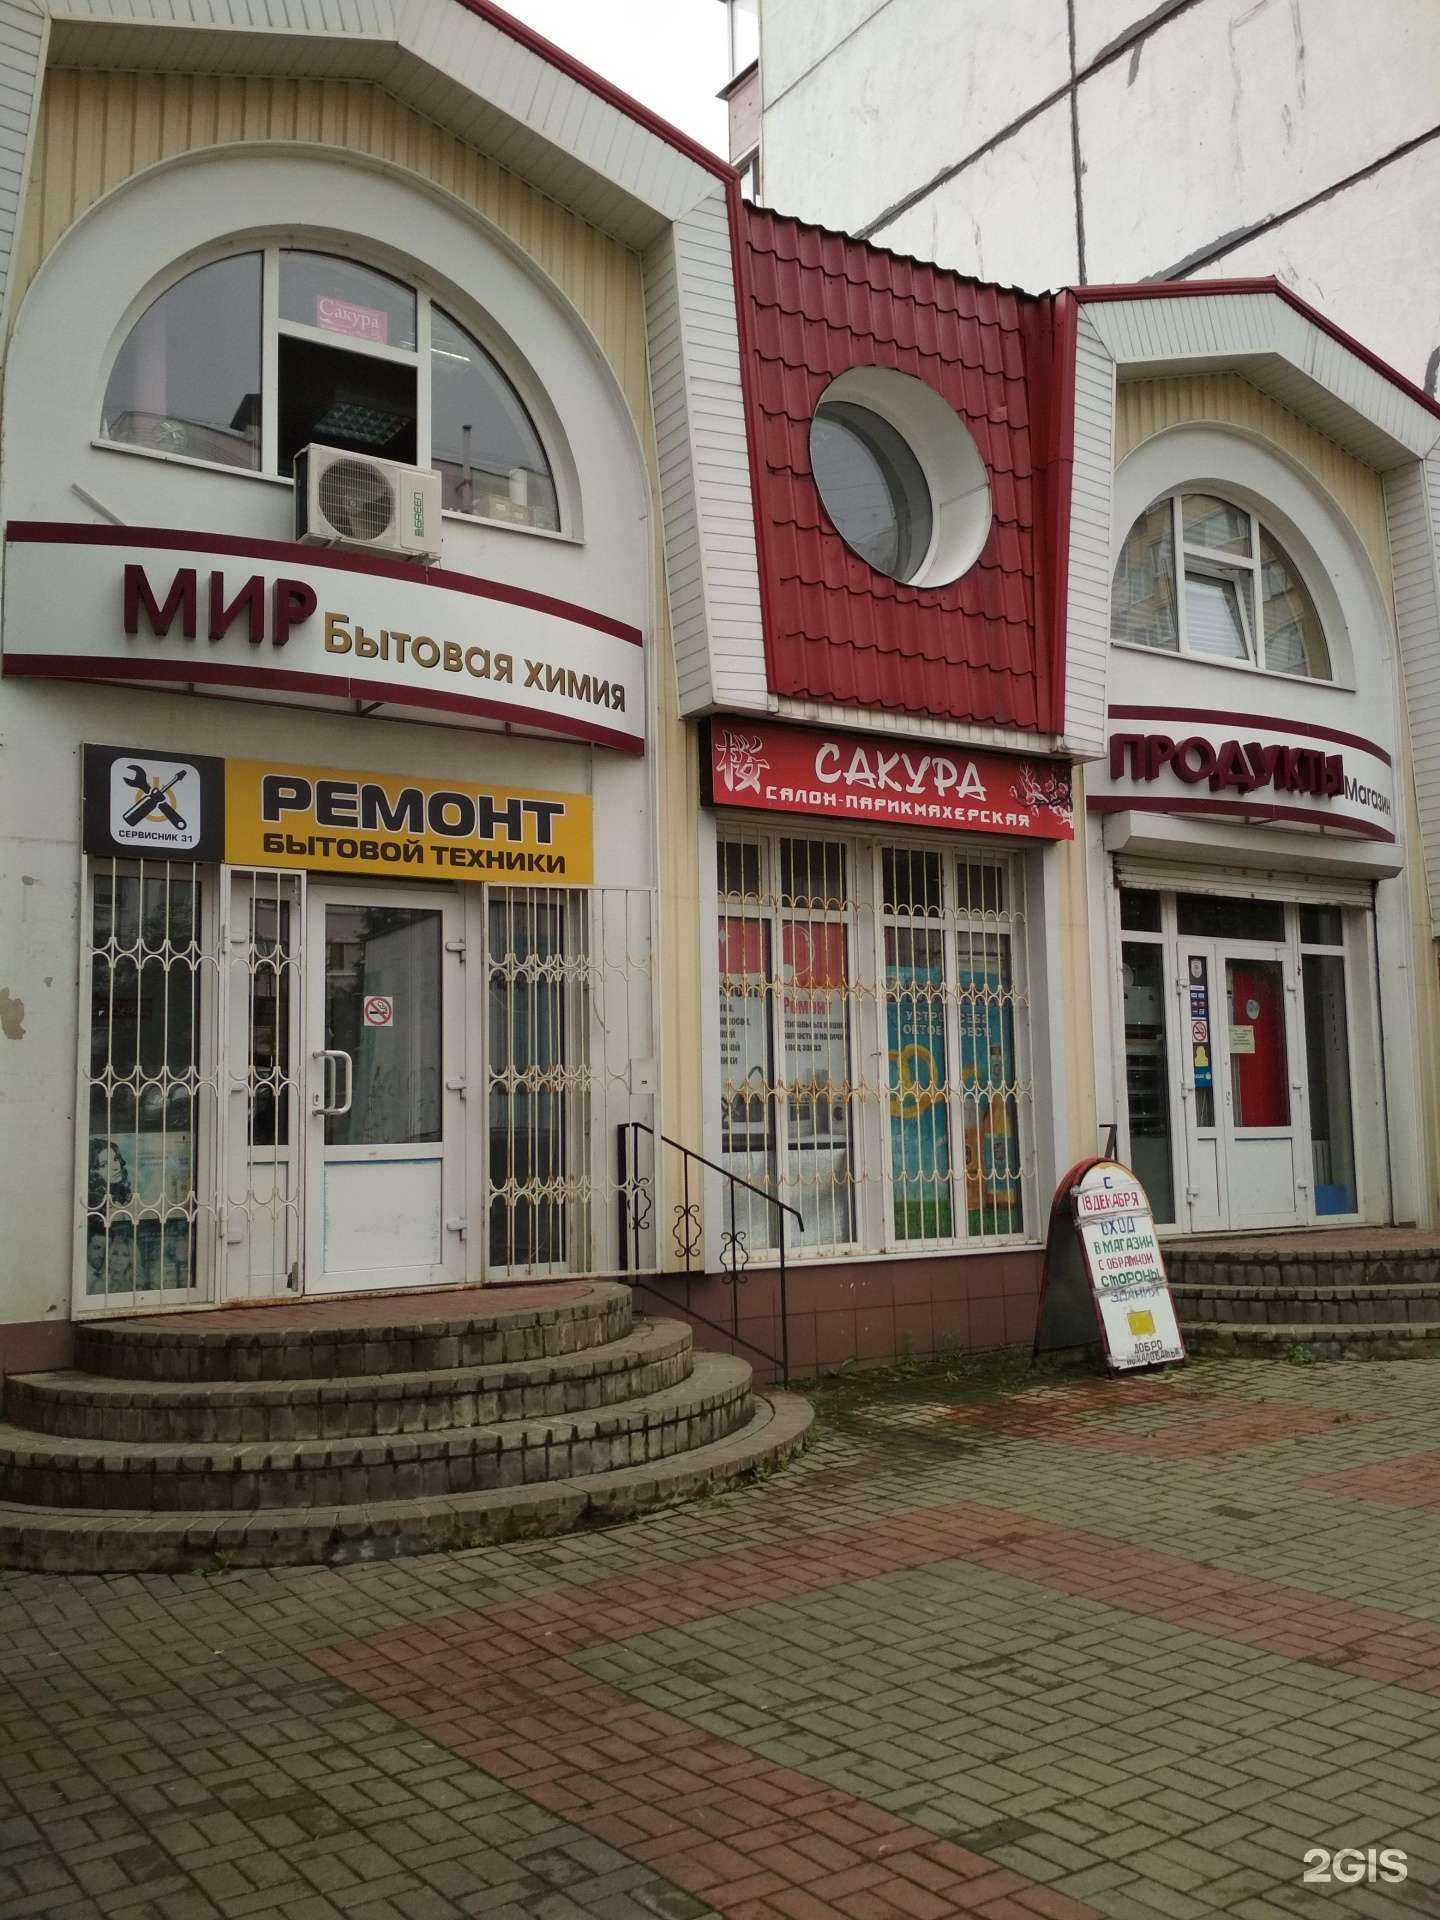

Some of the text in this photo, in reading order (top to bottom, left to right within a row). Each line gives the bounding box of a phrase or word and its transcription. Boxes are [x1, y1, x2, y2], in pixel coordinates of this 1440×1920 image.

[319, 298, 379, 330] Сакура
[123, 563, 318, 647] МИР
[324, 611, 514, 685] Бытовая
[814, 742, 987, 802] САКУРА
[1109, 732, 1344, 799] ПРОДУКТЫ
[261, 774, 565, 845] РЕМОНТ
[765, 785, 1031, 828] САЛОН-ПАРИКМАХЕРСКАЯ
[1344, 775, 1392, 816] Магазин
[118, 829, 193, 842] СЕРВИСНИК 31
[262, 832, 566, 875] БЫТОВОЙ ТЕХНИКИ
[1093, 1191, 1140, 1211] ДЕКАБРЯ
[1102, 1235, 1155, 1254] МАГАЗИН
[1134, 1339, 1163, 1354] ДОБРО
